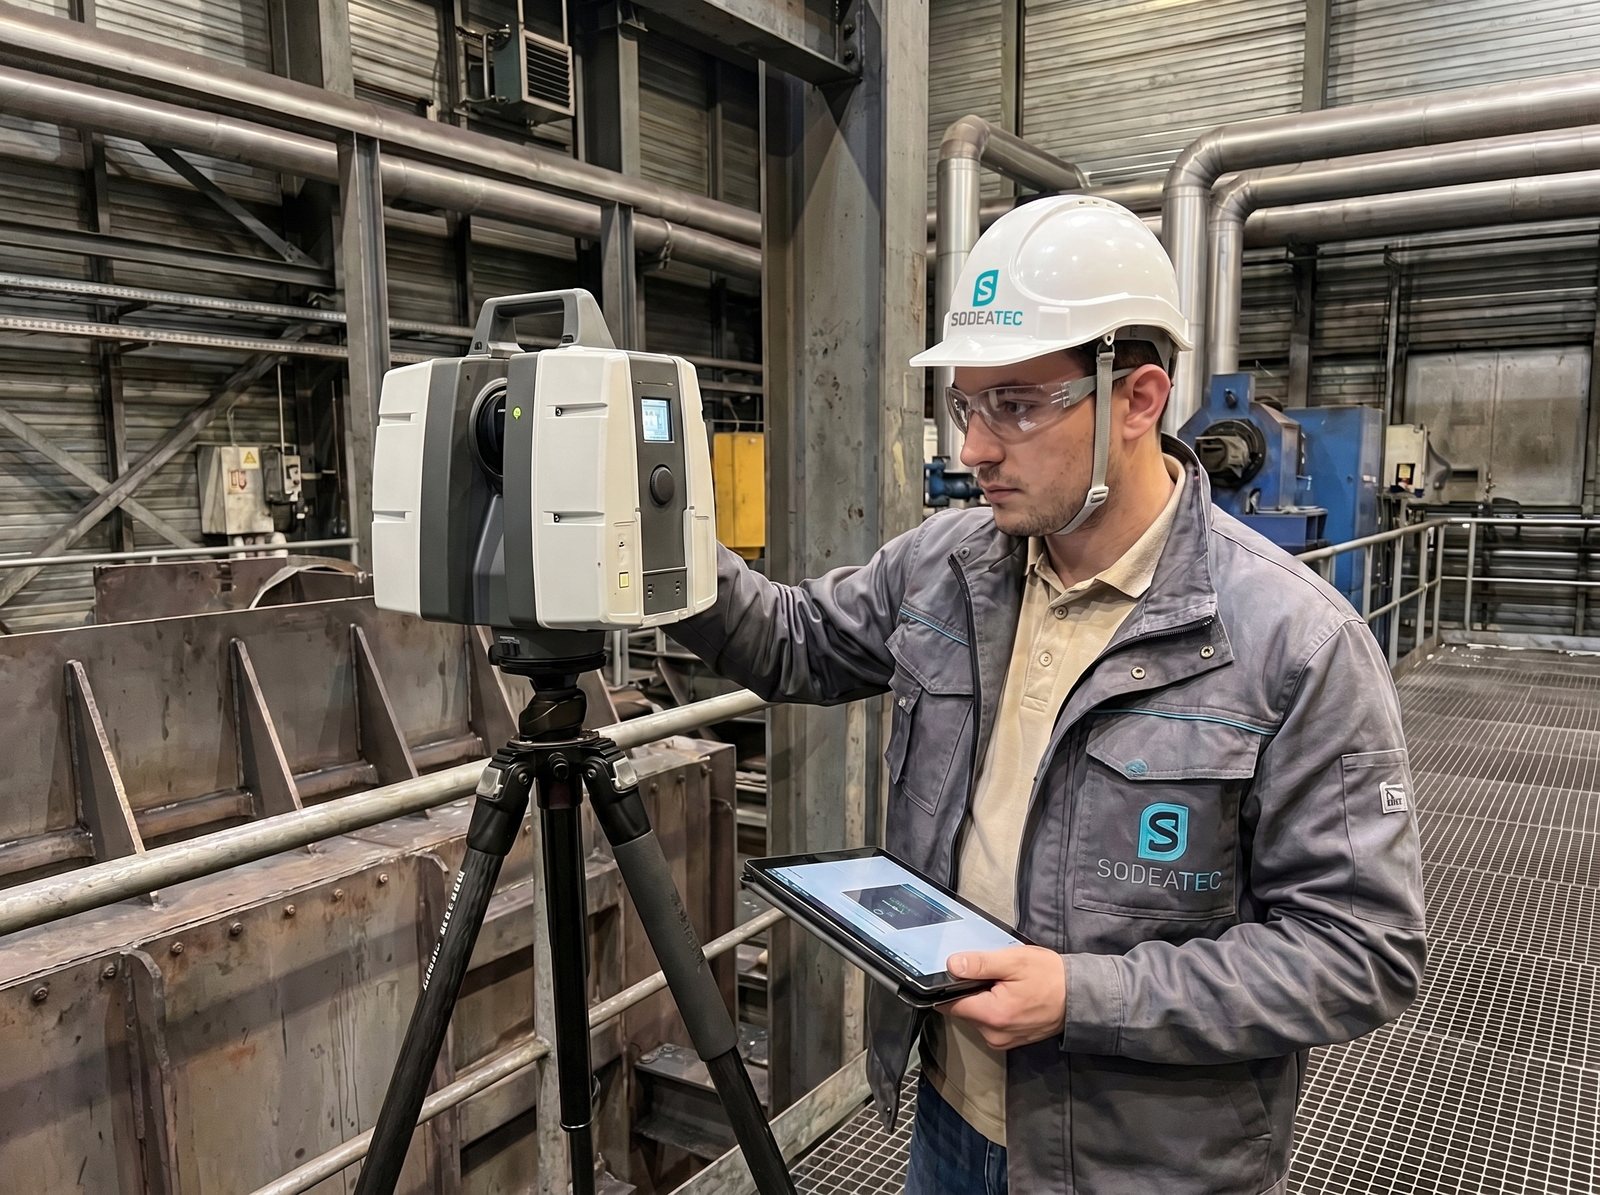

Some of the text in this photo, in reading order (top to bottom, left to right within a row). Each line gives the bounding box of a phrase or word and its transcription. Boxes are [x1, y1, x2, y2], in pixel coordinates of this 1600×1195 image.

[976, 274, 996, 303] S
[951, 310, 1023, 326] SODEATEC
[1147, 810, 1181, 854] S
[1097, 858, 1222, 892] SODEATEC
